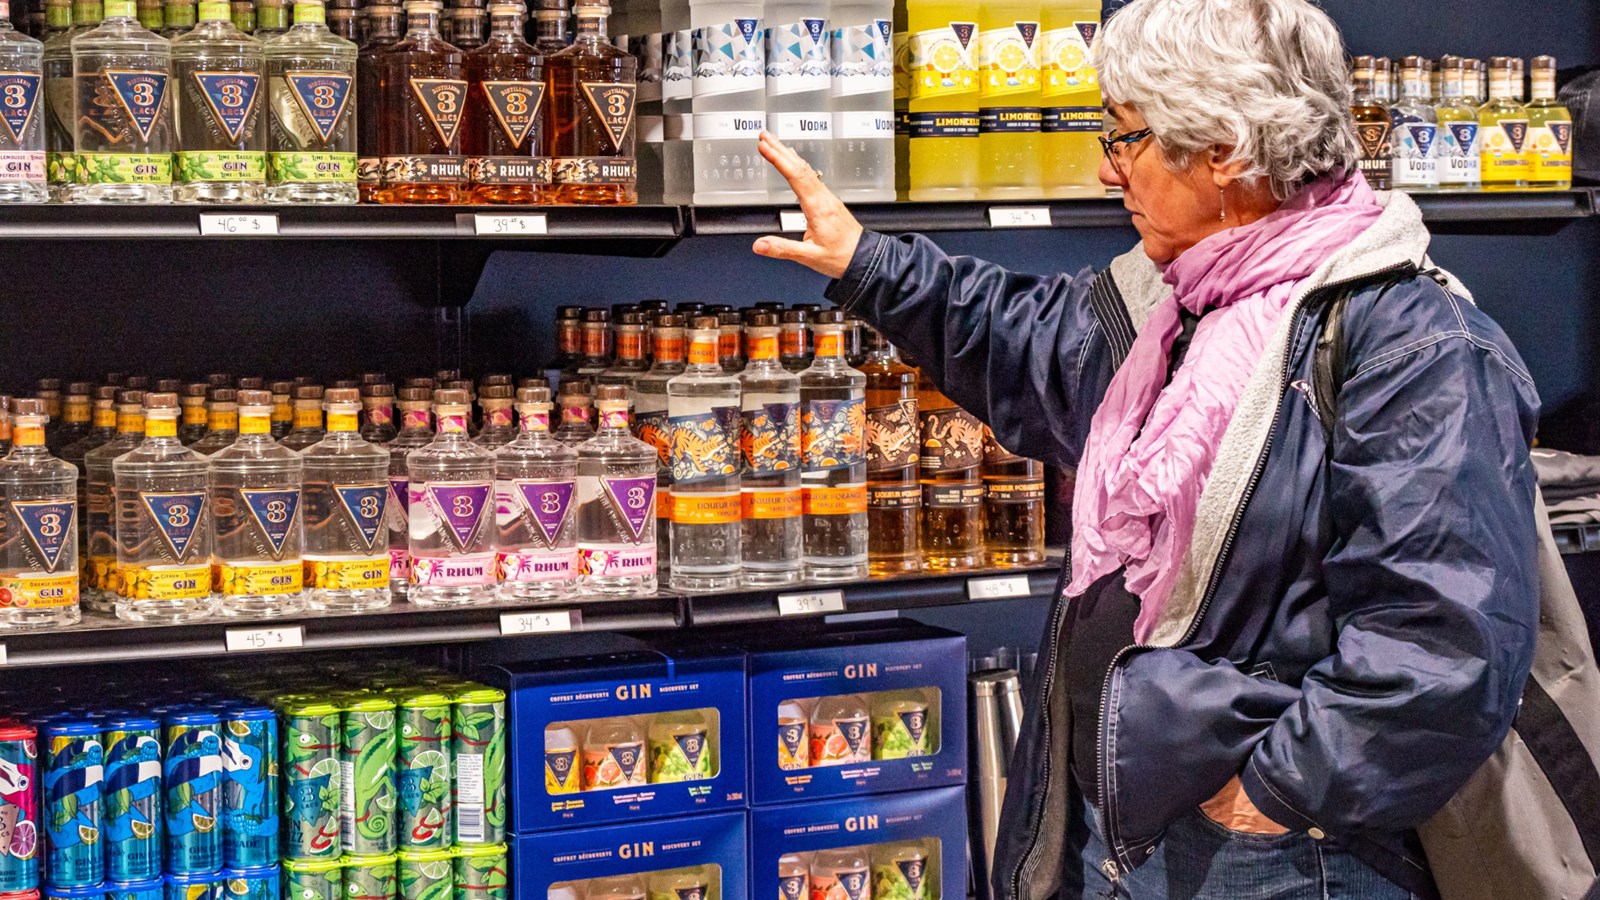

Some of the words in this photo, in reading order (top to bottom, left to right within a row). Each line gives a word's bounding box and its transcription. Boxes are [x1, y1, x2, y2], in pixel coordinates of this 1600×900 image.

[4, 84, 27, 108] 3
[133, 83, 155, 107] 3
[221, 84, 243, 107] 3
[314, 85, 335, 108] 3
[437, 91, 456, 113] 3
[506, 92, 528, 115] 3
[608, 94, 626, 116] 3
[5, 108, 28, 117] LACS
[132, 107, 156, 116] LACS
[220, 108, 245, 116] LACS
[312, 109, 336, 117] LACS
[435, 114, 458, 122] LACS
[505, 115, 529, 123] LACS
[607, 116, 626, 124] LACS
[7, 162, 31, 172] GIN
[134, 164, 158, 174] GIN
[222, 161, 248, 171] GIN
[316, 162, 341, 172] GIN
[431, 164, 461, 176] RHUM
[499, 165, 534, 177] RHUM
[602, 165, 631, 177] RHUM
[217, 217, 237, 233] 46
[493, 218, 509, 232] 39
[540, 491, 561, 514] 3
[627, 486, 646, 509] 3
[266, 500, 288, 523] 3
[360, 496, 379, 518] 3
[452, 495, 474, 517] 3
[168, 504, 191, 527] 3
[40, 513, 61, 537] 3
[534, 561, 569, 573] RHUM
[621, 556, 652, 567] RHUM
[362, 569, 383, 580] GIN
[446, 566, 483, 578] RHUM
[172, 579, 197, 590] GIN
[270, 575, 292, 586] GIN
[39, 588, 64, 599] GIN
[797, 598, 810, 611] 39
[518, 617, 533, 632] 34
[246, 633, 266, 648] 45
[783, 673, 805, 681] COFFRET
[844, 662, 878, 680] GIN
[549, 695, 574, 703] COFFRET
[615, 683, 652, 701] GIN
[659, 685, 688, 693] DISCOVERY
[783, 827, 806, 835] COFFRET
[845, 814, 879, 833] GIN
[618, 841, 655, 859] GIN
[661, 842, 690, 851] DISCOVERY
